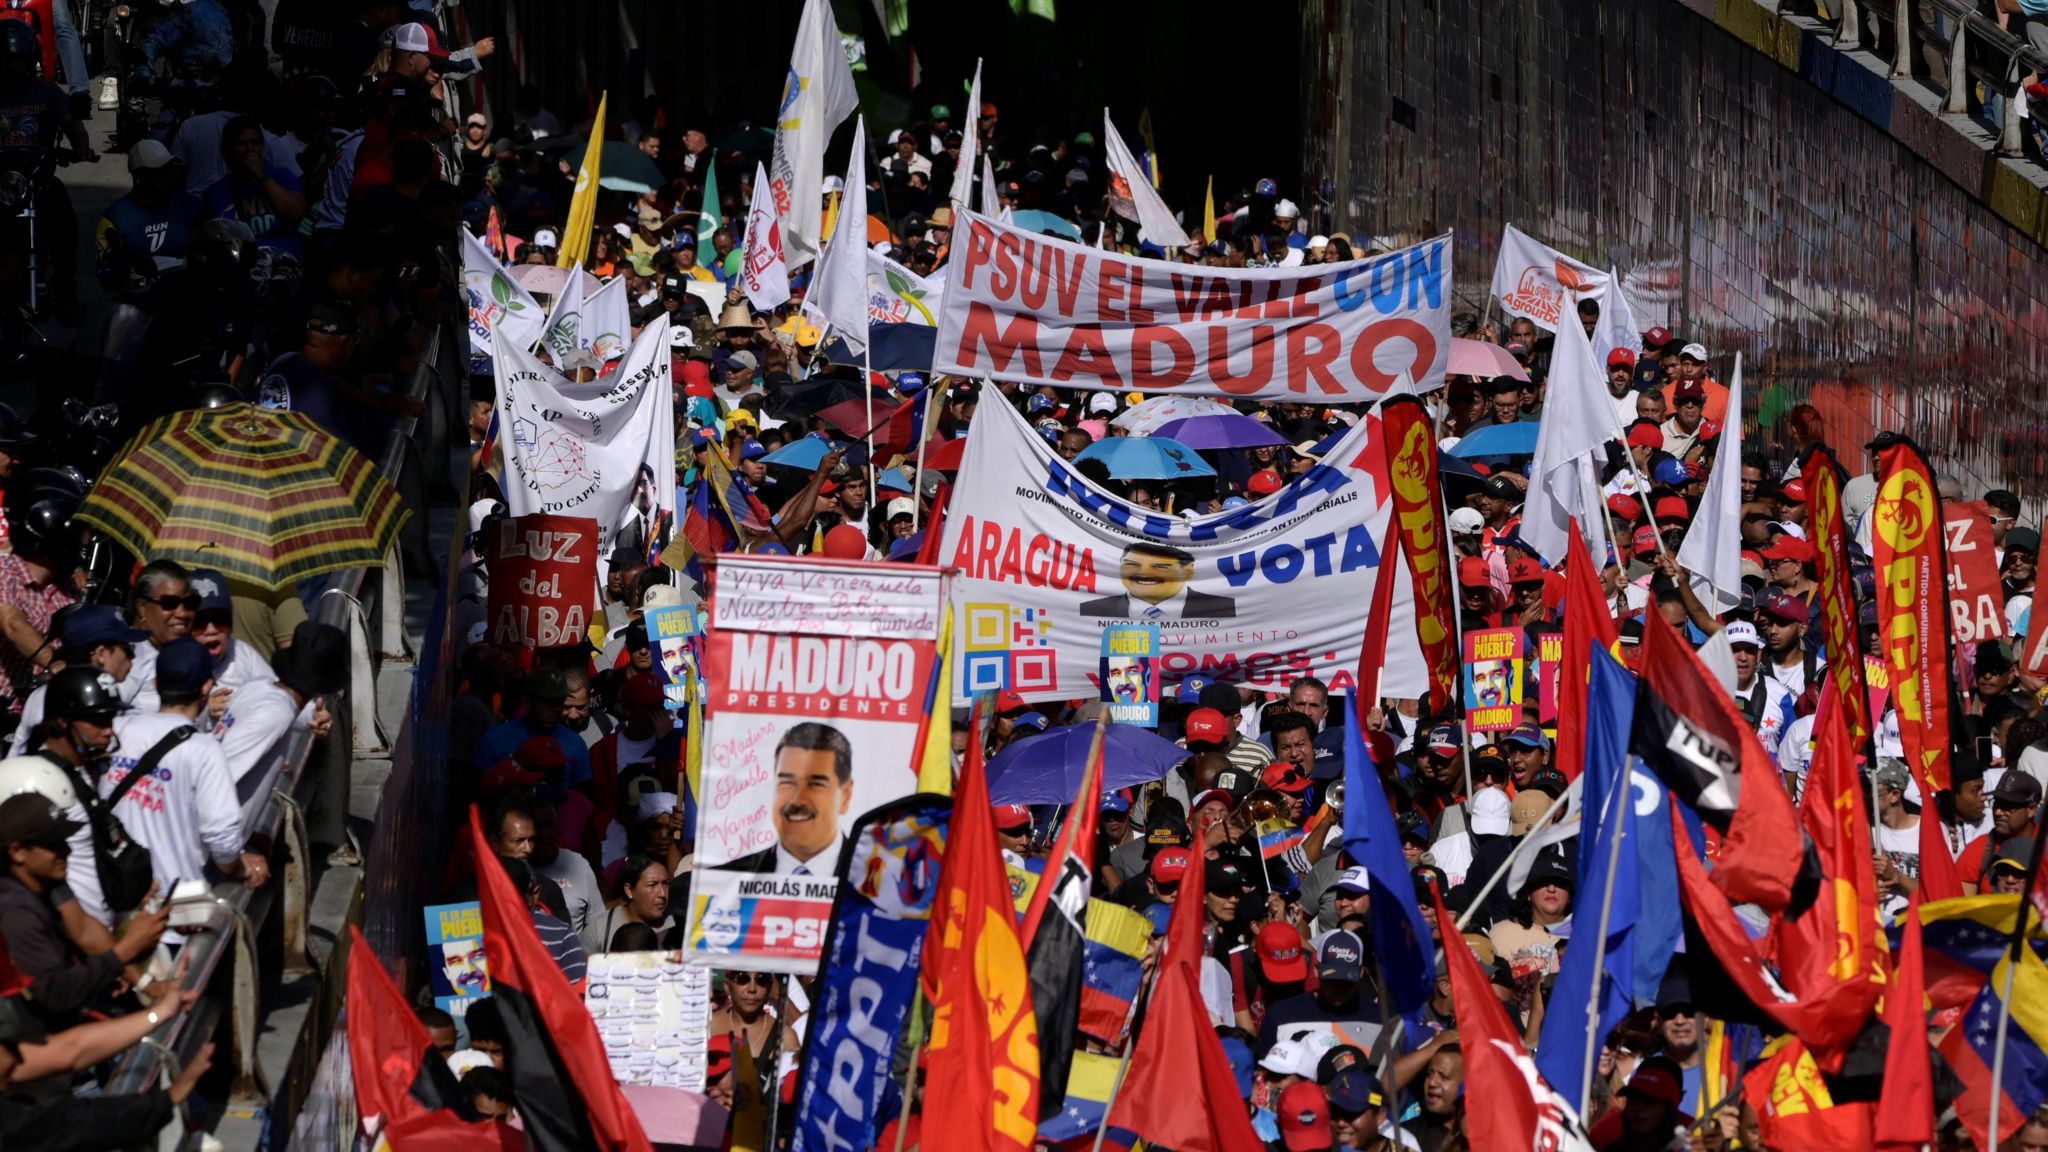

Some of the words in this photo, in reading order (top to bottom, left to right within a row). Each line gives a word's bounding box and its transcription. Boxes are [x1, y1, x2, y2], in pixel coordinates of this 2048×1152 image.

[145, 221, 168, 234] RUN
[962, 219, 1086, 318] PSUV
[1098, 260, 1147, 323] EL
[1172, 270, 1322, 323] VALLE
[1333, 240, 1443, 314] CON
[956, 301, 1437, 395] MADURO
[501, 519, 582, 564] LUZ
[952, 515, 1097, 593] ARAGUA
[1216, 526, 1380, 586] VOTA
[724, 567, 784, 590] Viva
[793, 569, 924, 599] Venezuela
[1920, 555, 1930, 596] PARTIDO
[494, 604, 585, 648] ALBA
[658, 617, 694, 636] PUEBLO
[1160, 619, 1220, 629] MADURO
[1160, 629, 1299, 646] OVIMIENTO
[1728, 626, 1744, 636] MIRA
[1920, 598, 1930, 655] COMUNISTA
[1950, 594, 2003, 644] BA
[1109, 638, 1151, 655] PUEBLO
[1161, 648, 1311, 673] OMOS
[1474, 640, 1514, 660] PUEBLO
[1921, 657, 1929, 670] DE
[729, 632, 916, 701] MADURO
[727, 691, 908, 716] PRESIDENTE
[1473, 708, 1513, 727] MADURO
[1921, 673, 1934, 729] VENEZUELA
[711, 720, 776, 768] Maduro
[714, 766, 769, 810] Pueblo
[707, 803, 768, 846] Vamos
[727, 827, 774, 860] Nico
[739, 878, 801, 897] NICOLÁS
[827, 910, 909, 1123] PPT
